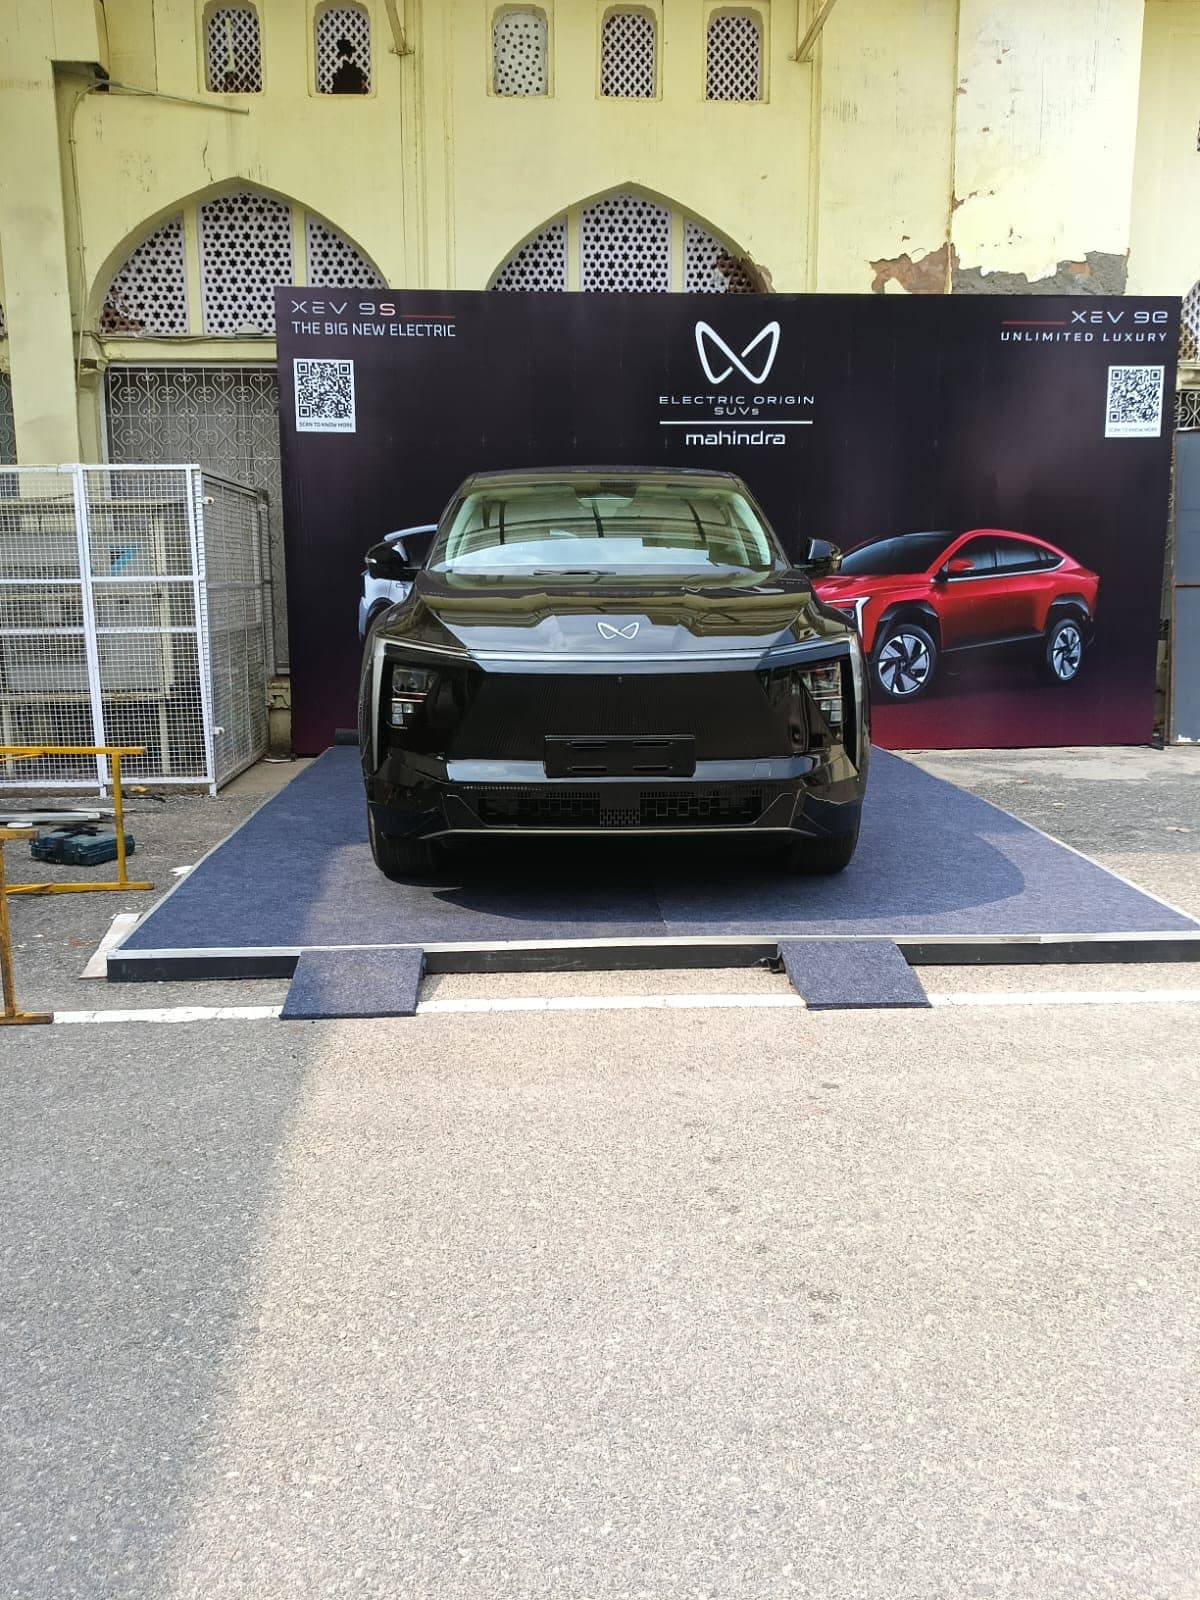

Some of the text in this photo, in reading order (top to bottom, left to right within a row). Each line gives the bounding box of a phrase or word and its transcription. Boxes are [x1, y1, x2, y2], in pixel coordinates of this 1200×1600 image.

[291, 300, 396, 316] XEV 9S
[1071, 310, 1125, 324] XEV
[291, 321, 456, 337] THE BIG NEW ELECTRIC
[1000, 331, 1168, 342] UNLIMITED LUXURY
[659, 396, 815, 405] ELECTRIC ORIGIN
[713, 407, 760, 416] SUVs
[685, 430, 786, 446] mahindra
